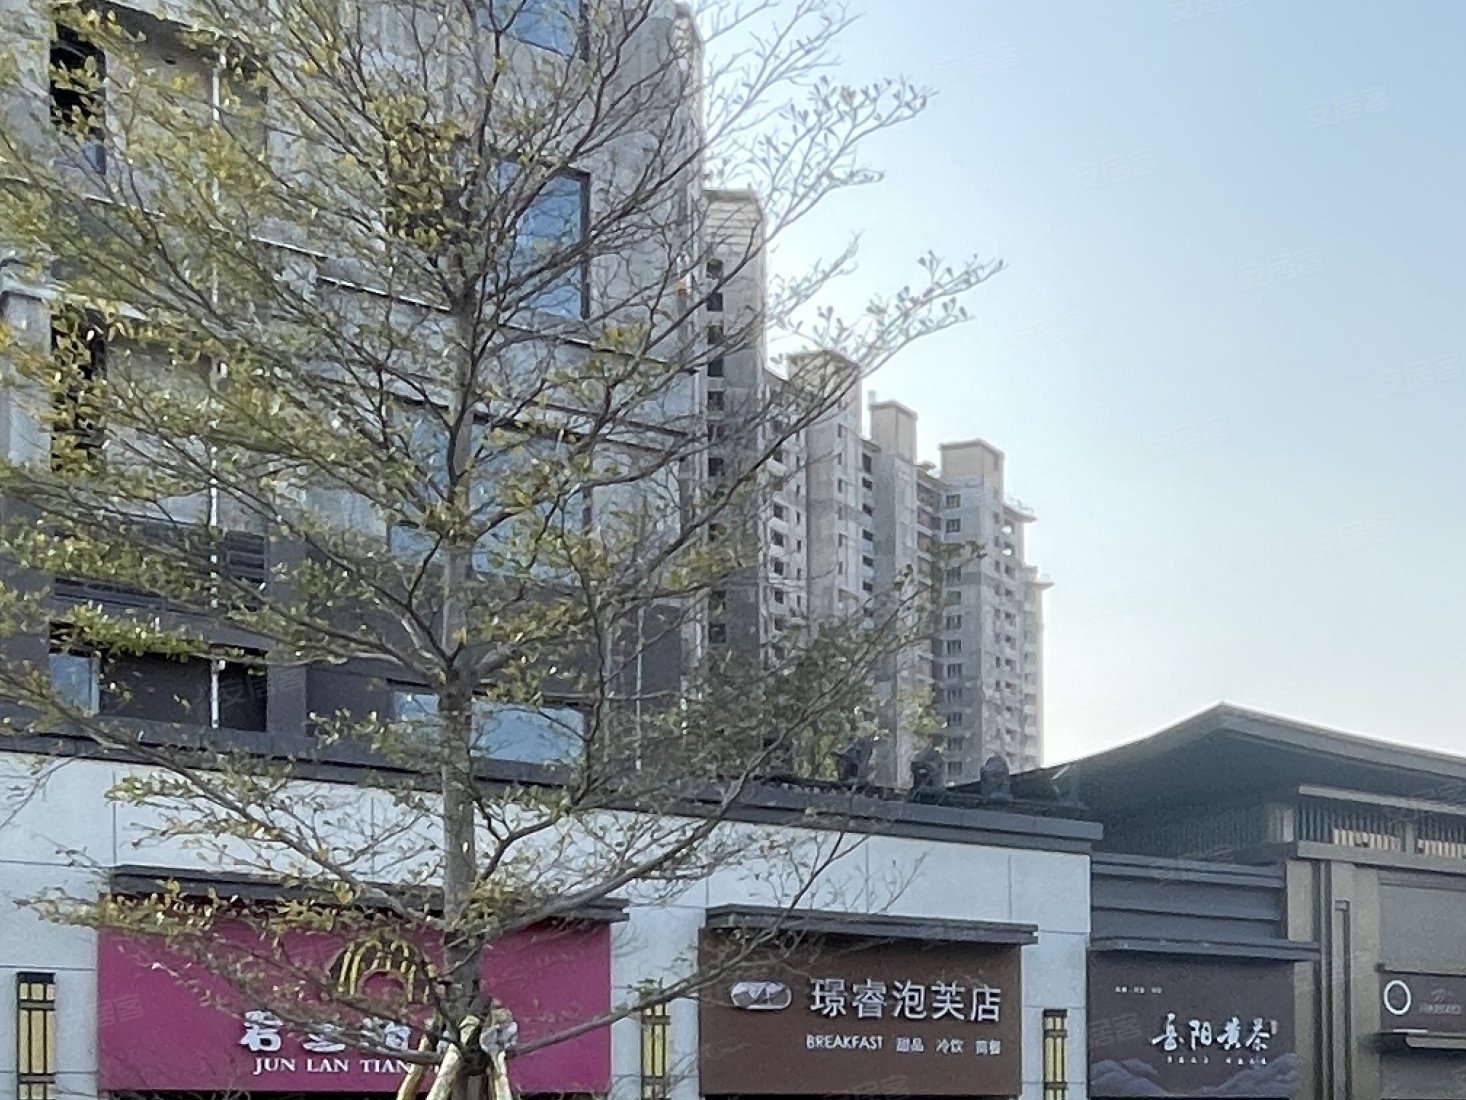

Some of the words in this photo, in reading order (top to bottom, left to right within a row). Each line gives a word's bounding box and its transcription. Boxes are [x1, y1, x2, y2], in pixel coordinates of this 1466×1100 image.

[809, 978, 1001, 1023] 璟睿泡芙店
[806, 1034, 884, 1050] BREAKFAST
[252, 1057, 296, 1075] JUN
[306, 1057, 349, 1073] LAN
